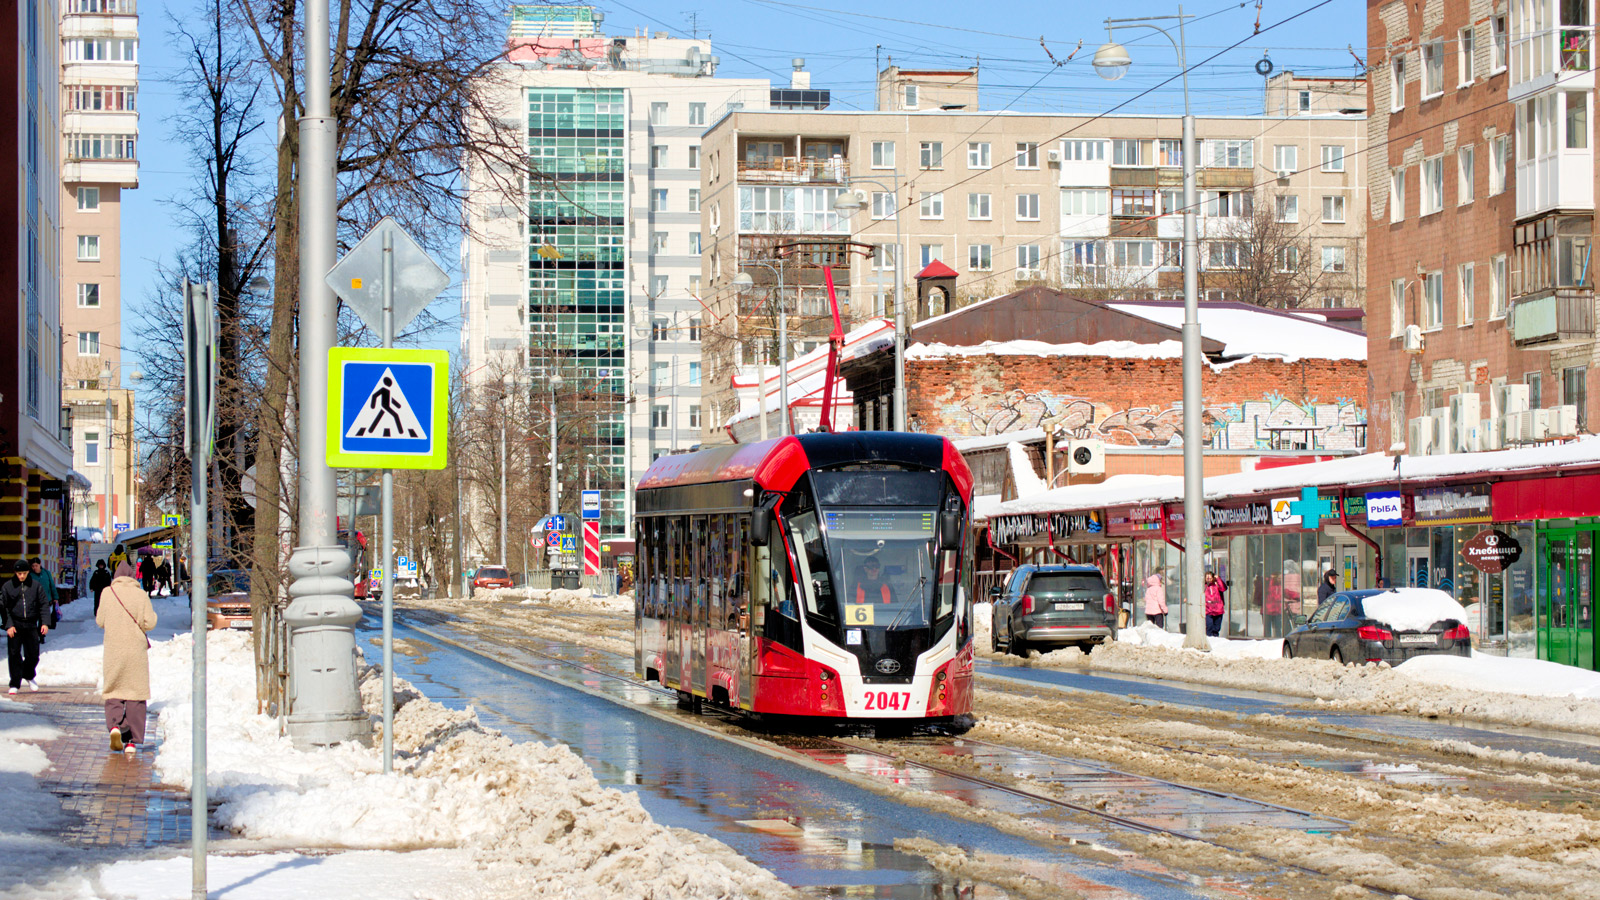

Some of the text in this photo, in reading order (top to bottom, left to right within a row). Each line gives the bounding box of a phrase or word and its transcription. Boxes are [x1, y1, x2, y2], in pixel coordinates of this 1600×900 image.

[1209, 502, 1269, 528] Строительный Двор
[1370, 504, 1398, 514] РЫБА
[1468, 546, 1517, 556] Хлебница
[854, 607, 868, 623] 6
[863, 691, 911, 711] 2047
